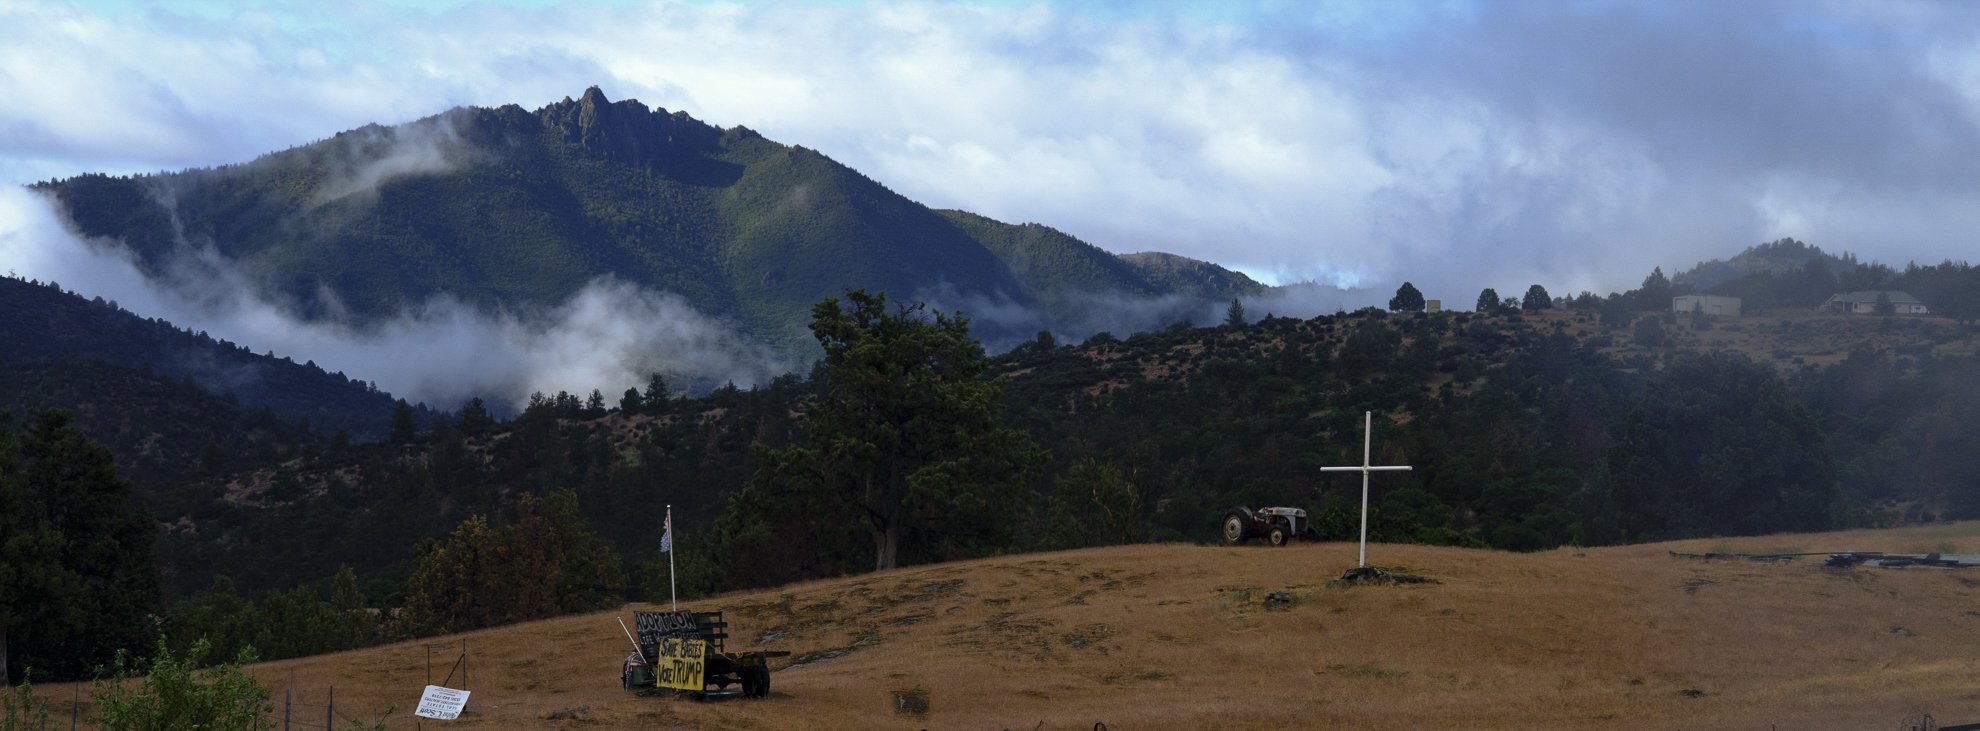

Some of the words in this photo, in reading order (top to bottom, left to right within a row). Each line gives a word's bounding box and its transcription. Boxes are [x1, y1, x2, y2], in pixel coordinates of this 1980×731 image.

[636, 612, 697, 632] ADOPTION
[640, 635, 655, 645] LIFE
[661, 638, 677, 657] SAVE
[681, 640, 703, 659] BABIES
[659, 664, 673, 684] VOTE
[673, 659, 702, 686] TRUMP
